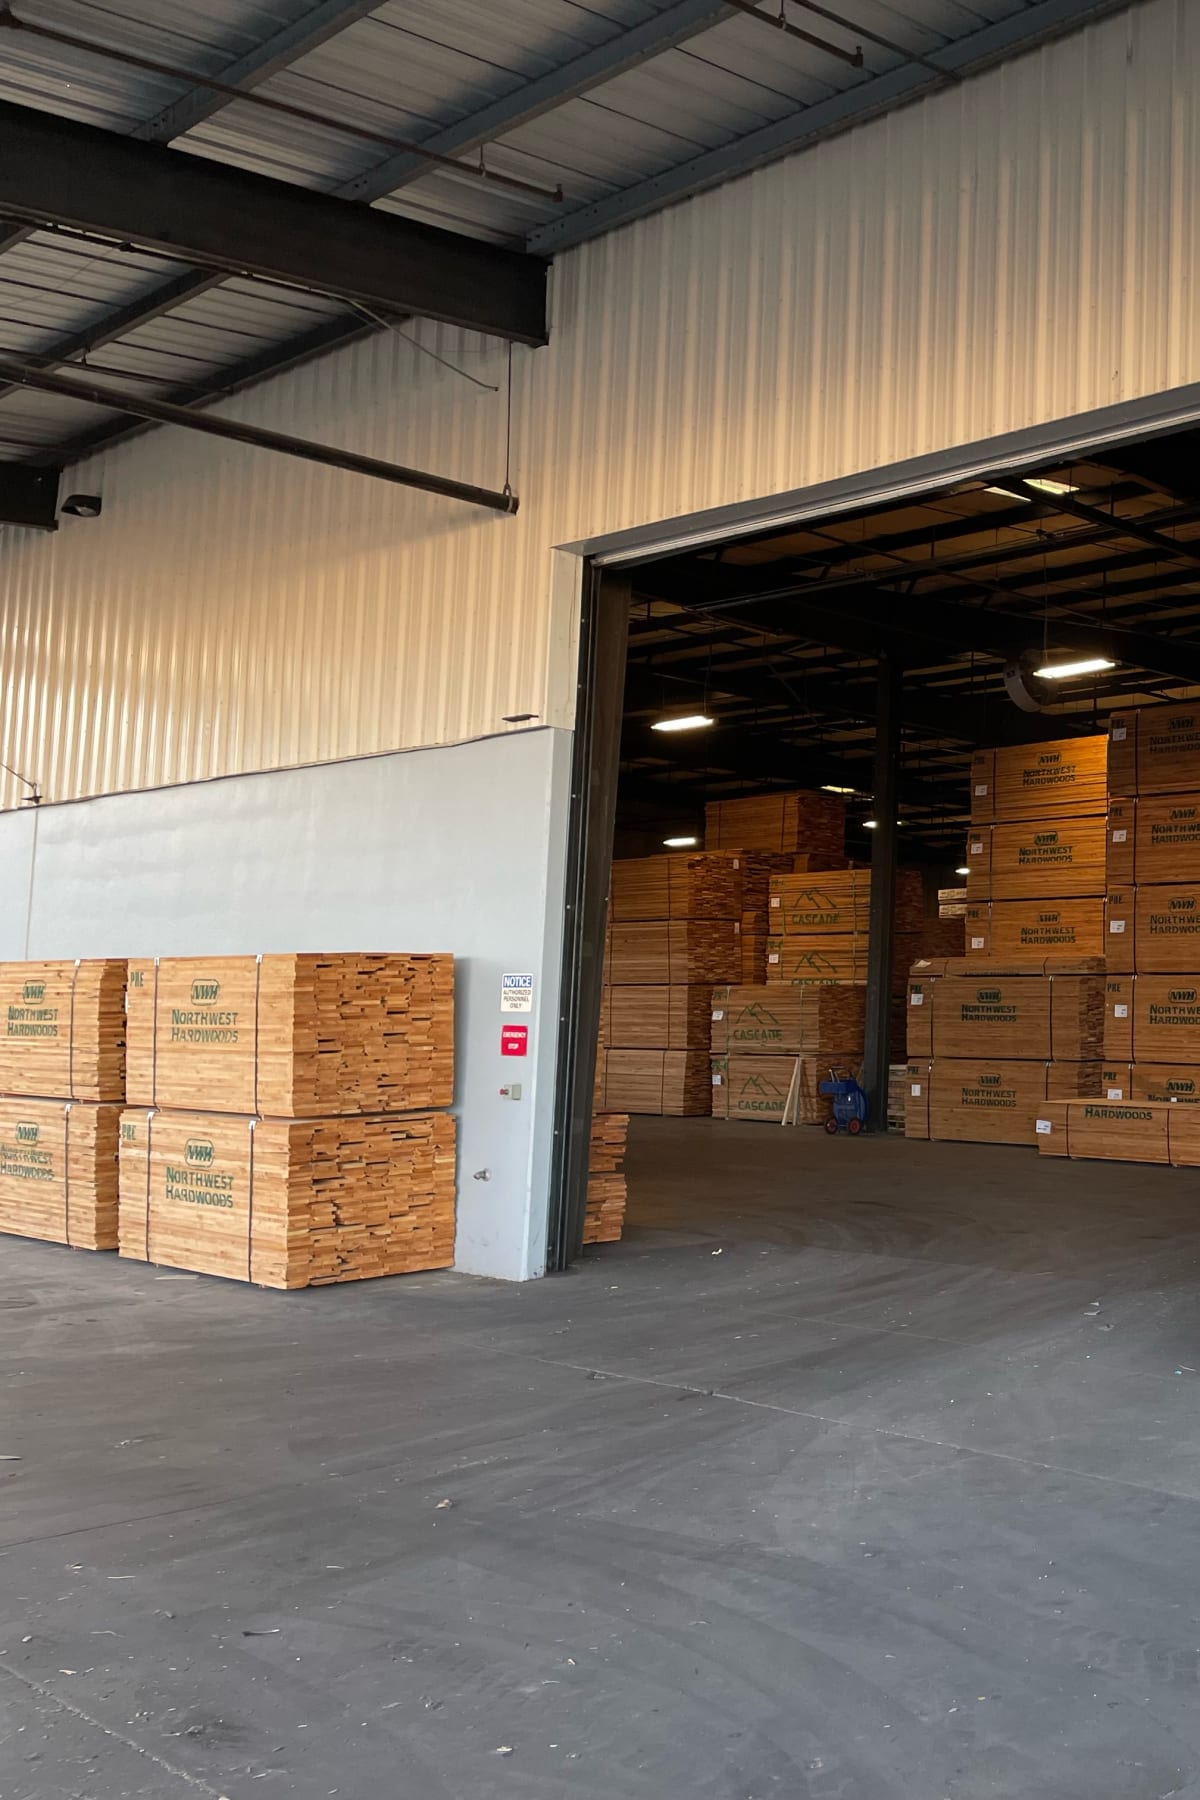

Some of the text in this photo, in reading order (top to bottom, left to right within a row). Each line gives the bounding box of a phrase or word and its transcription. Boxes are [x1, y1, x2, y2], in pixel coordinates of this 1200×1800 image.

[1023, 766, 1076, 778] NORTHWEST
[1023, 775, 1076, 786] HARDWOODS
[1171, 808, 1196, 820] NWH
[1018, 846, 1073, 857] NORTHWEST
[1018, 855, 1073, 865] HARDWOODS
[1169, 900, 1195, 911] NWH
[1020, 926, 1076, 936] NORTHWEST
[1020, 935, 1076, 945] HARDWOODS
[504, 976, 532, 987] NOTICE
[23, 985, 45, 999] NWH
[191, 985, 219, 1000] NWH
[1107, 983, 1121, 993] PRE
[1169, 991, 1195, 1001] NWH
[7, 1005, 59, 1021] NORTHWEST
[961, 1004, 1017, 1013] NORTHWEST
[171, 1008, 239, 1026] NORTHWEST
[961, 1013, 1017, 1022] HARDWOODS
[7, 1021, 58, 1037] HARDWOODS
[170, 1026, 239, 1043] HARDWOODS
[733, 1029, 783, 1041] CASCADE
[1103, 1071, 1117, 1081] PRE
[1168, 1082, 1194, 1092] NWH
[961, 1088, 1017, 1099] NORTHWEST
[961, 1098, 1017, 1108] HARDWOODS
[1084, 1106, 1153, 1121] HARDWOODS
[17, 1126, 38, 1141] NWH
[122, 1124, 137, 1140] PRE
[187, 1145, 214, 1161] NWH
[0, 1160, 55, 1180] HARDWOODS
[165, 1166, 235, 1190] NORTHWEST
[165, 1185, 234, 1209] HARDWOODS
